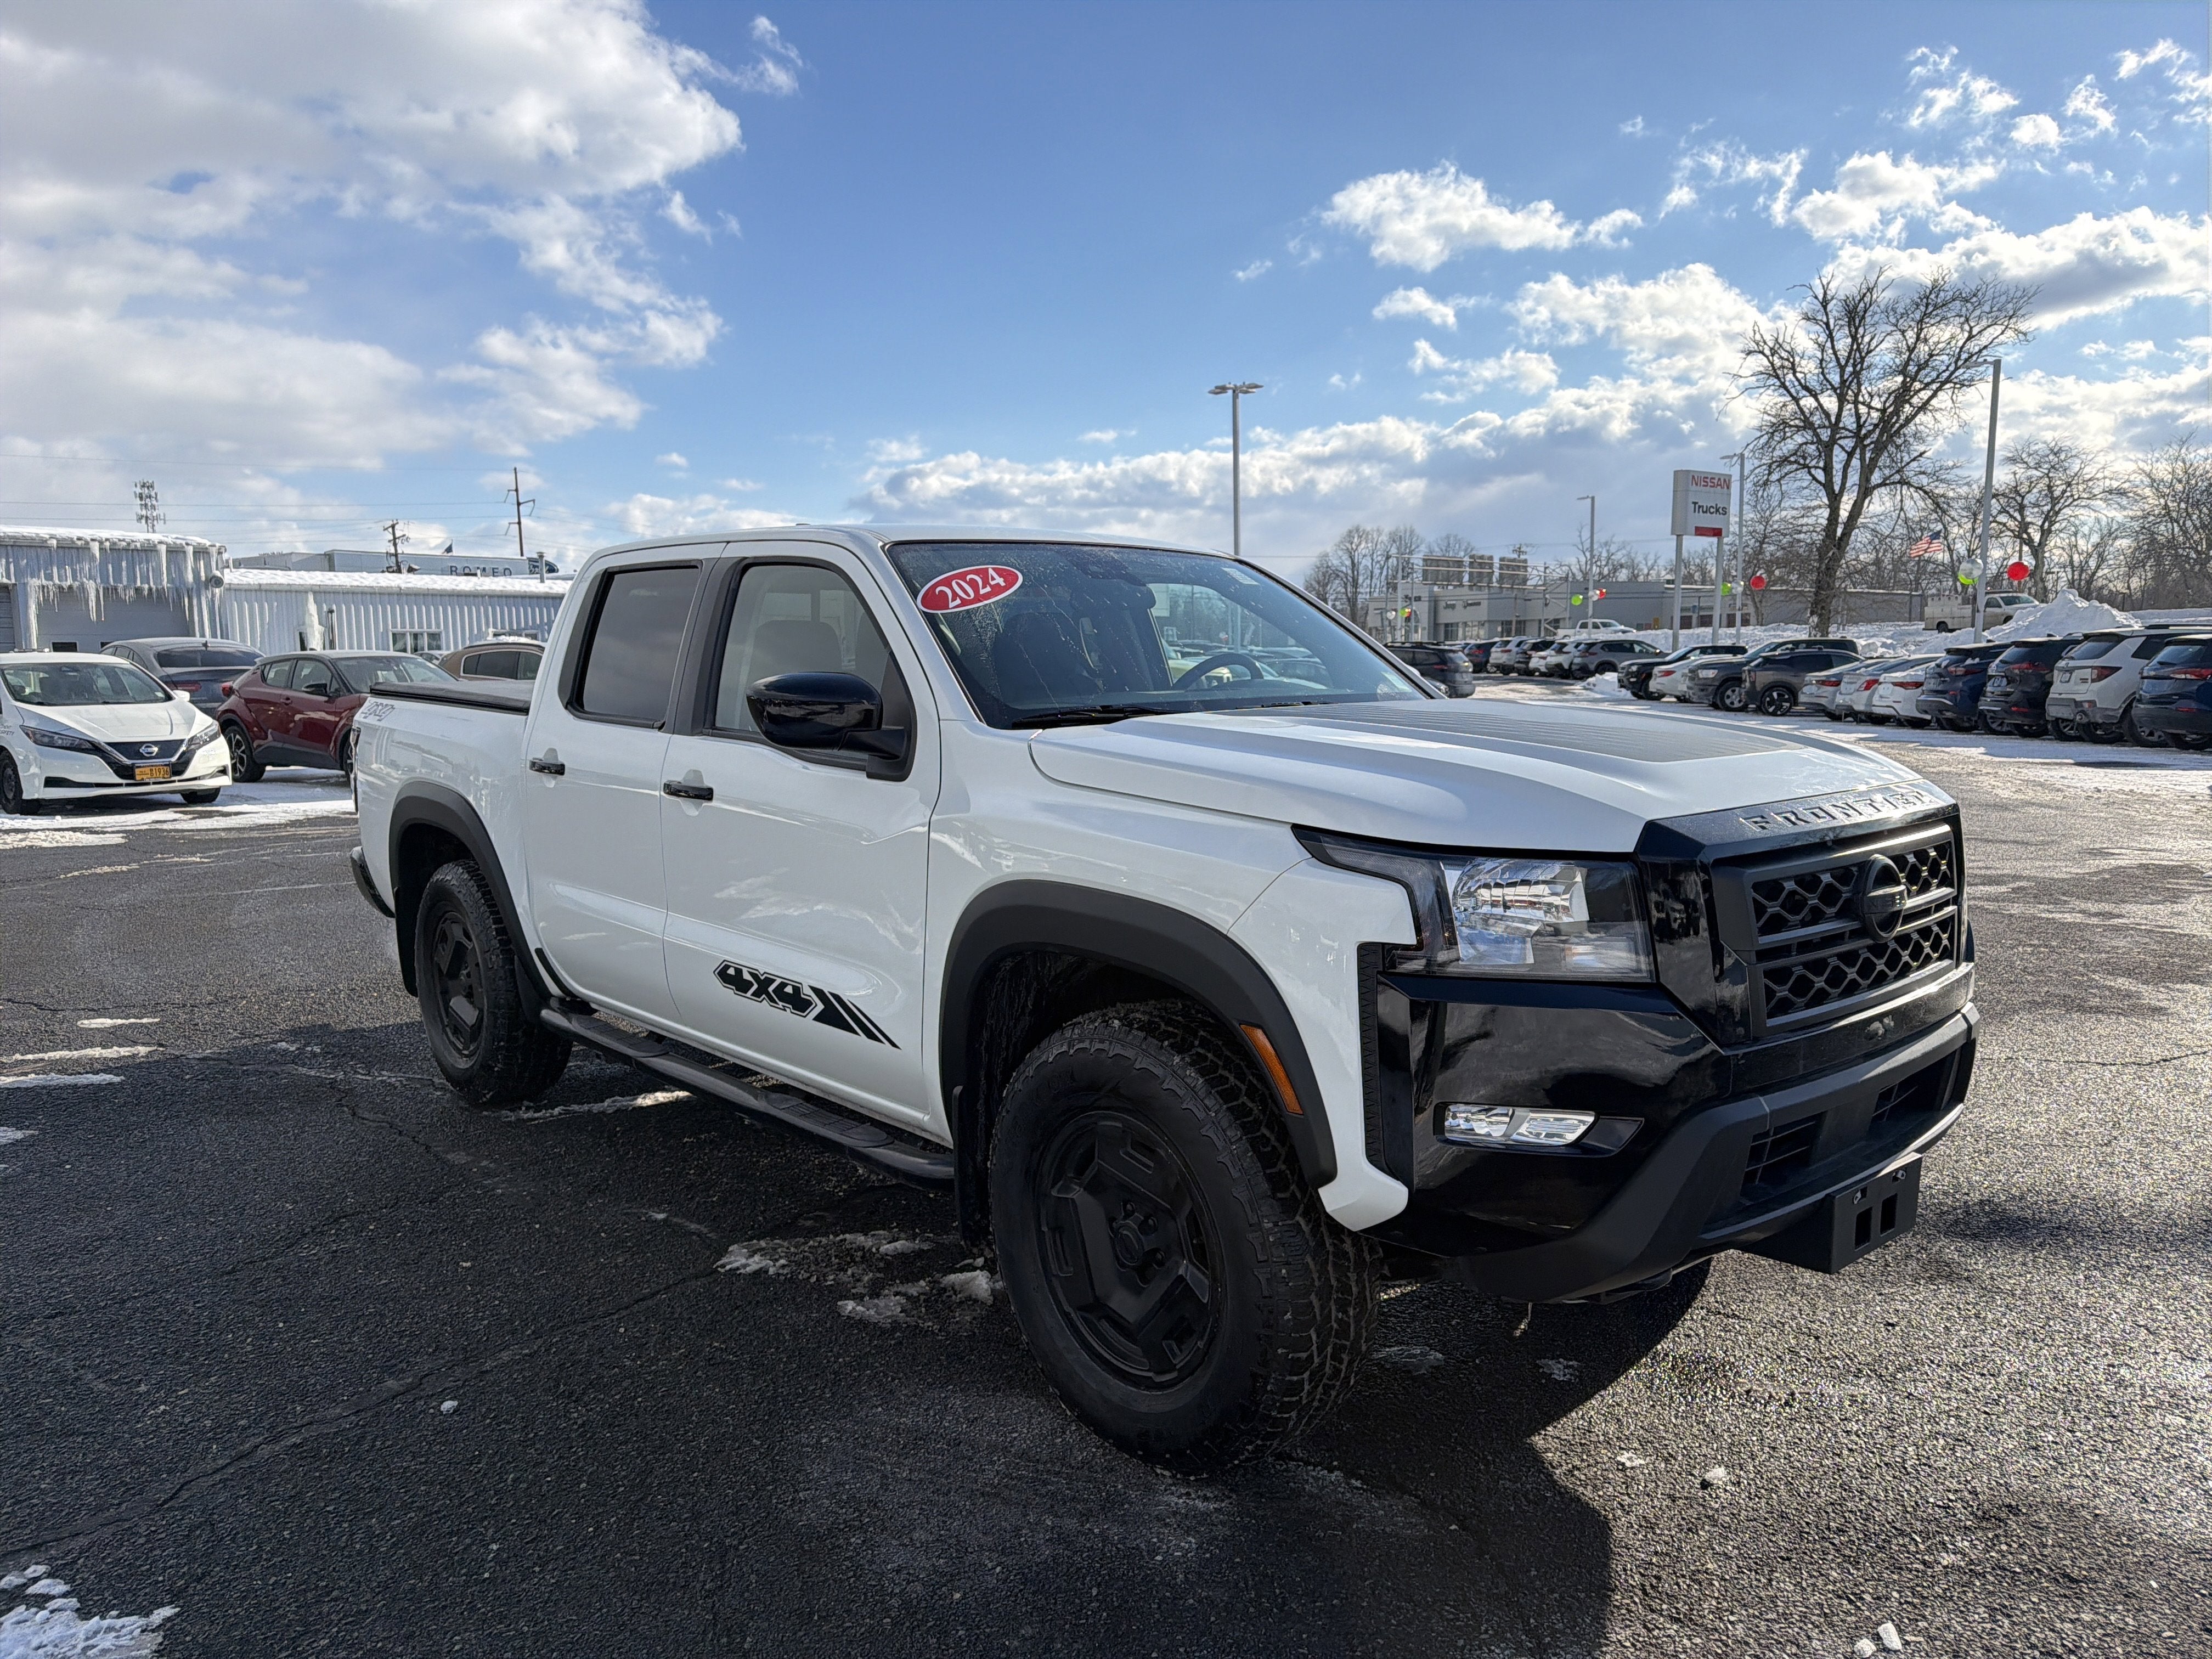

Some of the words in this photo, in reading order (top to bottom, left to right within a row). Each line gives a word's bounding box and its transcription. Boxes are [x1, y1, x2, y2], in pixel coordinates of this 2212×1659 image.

[1691, 475, 1730, 489] NISSAN
[1691, 501, 1728, 516] Trucks
[449, 565, 512, 577] ROMEO
[935, 567, 1006, 608] 2024
[1739, 789, 1939, 832] FRONTIER
